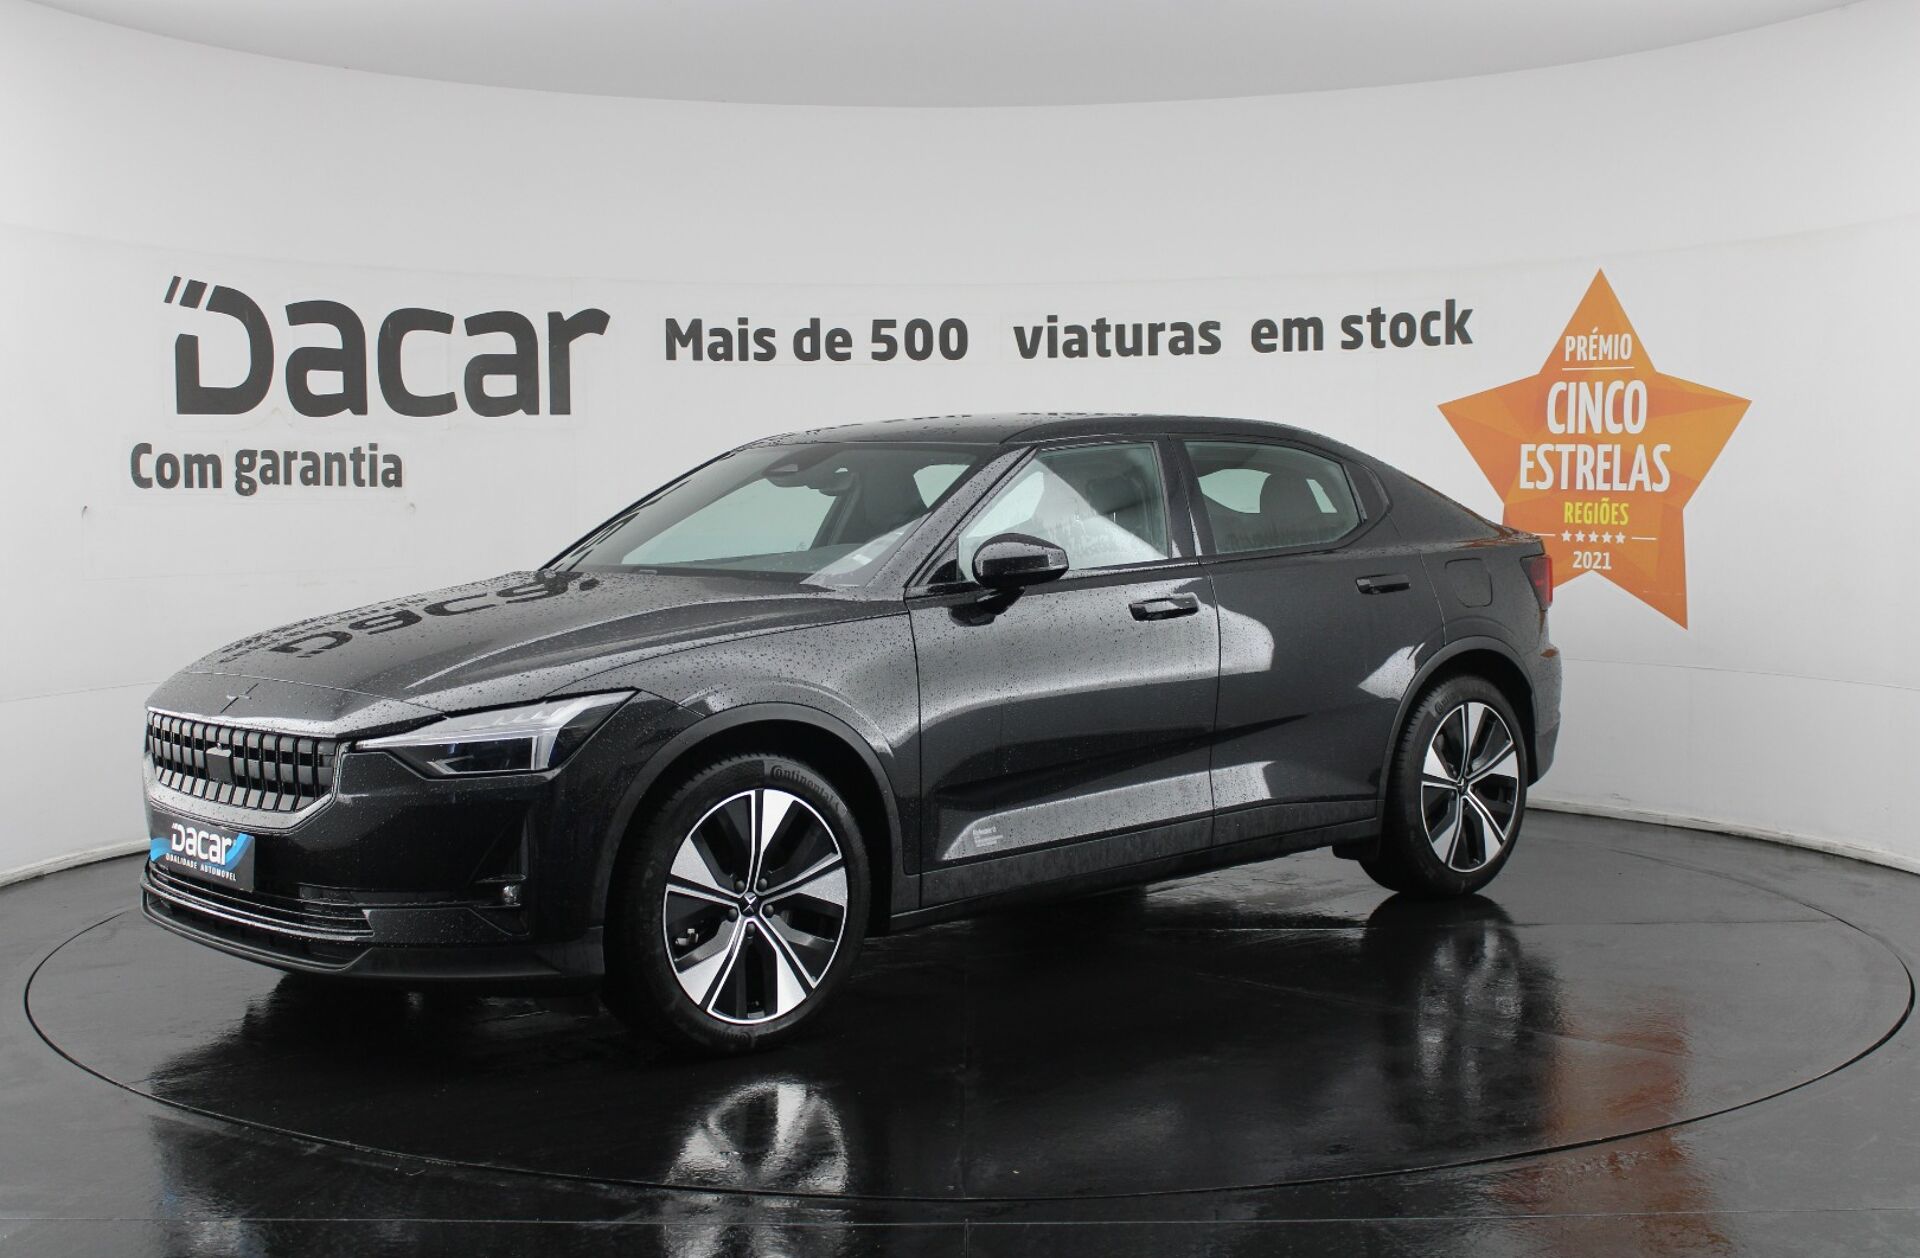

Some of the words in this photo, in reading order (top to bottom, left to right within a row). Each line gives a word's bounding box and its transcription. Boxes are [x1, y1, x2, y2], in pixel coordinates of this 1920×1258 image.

[164, 276, 611, 417] Dacar
[666, 318, 776, 361] Mais
[793, 318, 852, 361] de
[872, 318, 967, 361] 500
[1014, 315, 1221, 359] viaturas
[1251, 317, 1323, 353] em
[1342, 299, 1472, 349] stock
[1564, 327, 1632, 361] PRÉMIO
[1547, 380, 1648, 434] CINCO
[131, 443, 221, 488] Com
[235, 443, 402, 496] garantia
[1519, 444, 1671, 492] ESTRELAS
[1563, 497, 1629, 525] REGIÕES
[1573, 551, 1611, 571] 2021
[770, 764, 836, 803] Continental
[165, 852, 198, 869] QUALIDADE
[171, 822, 232, 866] Dacar
